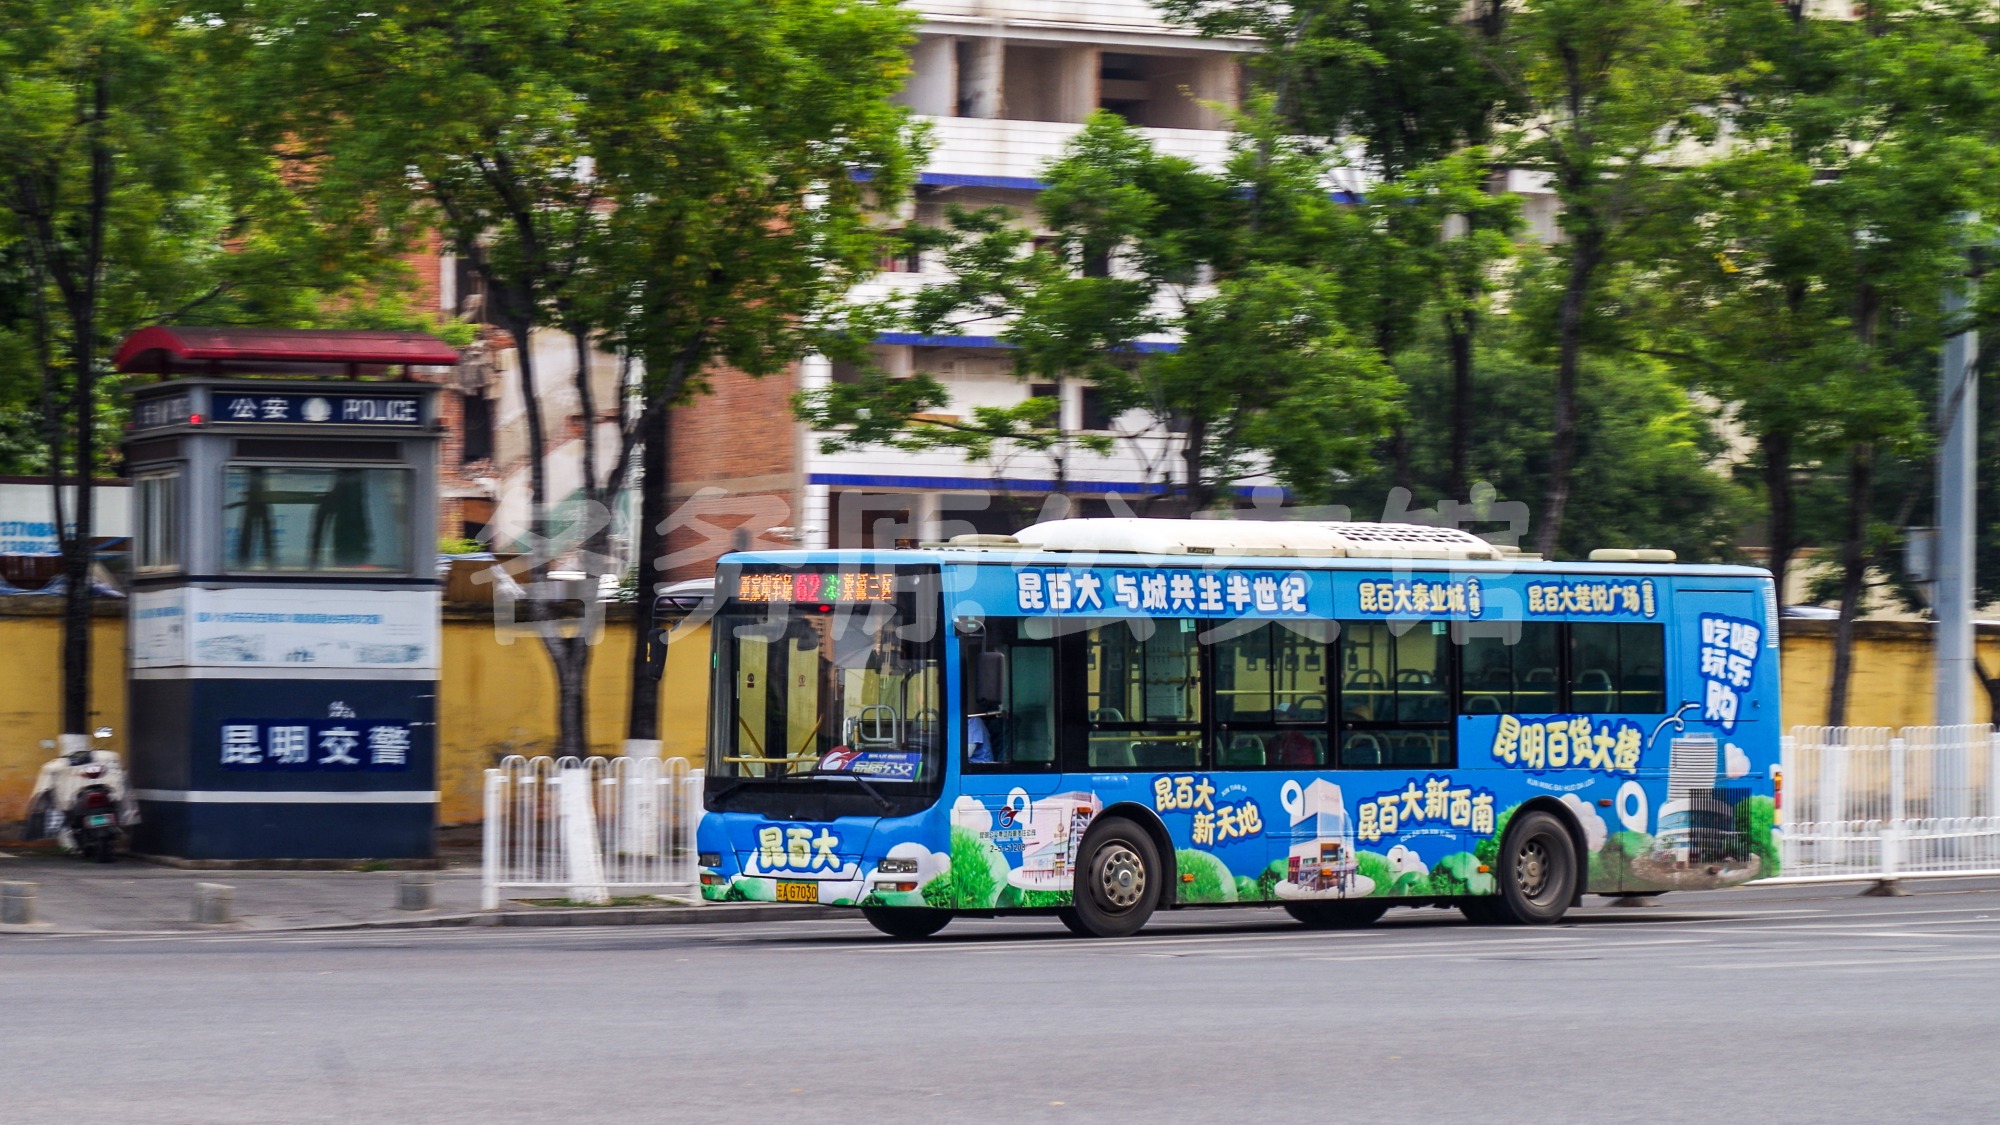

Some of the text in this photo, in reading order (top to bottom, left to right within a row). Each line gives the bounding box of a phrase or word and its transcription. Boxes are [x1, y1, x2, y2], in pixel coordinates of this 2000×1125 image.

[228, 397, 289, 420] 公安
[342, 398, 417, 421] POLICE
[795, 573, 821, 602] 62
[1017, 572, 1307, 612] 昆百大 与城共生半世纪
[1358, 582, 1466, 613] 昆百大泰业城
[1527, 583, 1640, 613] 昆百大楚悦广场
[1701, 618, 1760, 660] 吃喝
[1701, 647, 1751, 688] 玩乐
[1707, 680, 1738, 730] 购
[219, 724, 411, 768] 昆明交警
[1492, 714, 1642, 775] 昆明百货大楼
[1154, 775, 1216, 812] 昆百大
[1357, 777, 1494, 841] 昆百大新西南
[1192, 801, 1263, 847] 新天地
[758, 827, 840, 870] 昆百大
